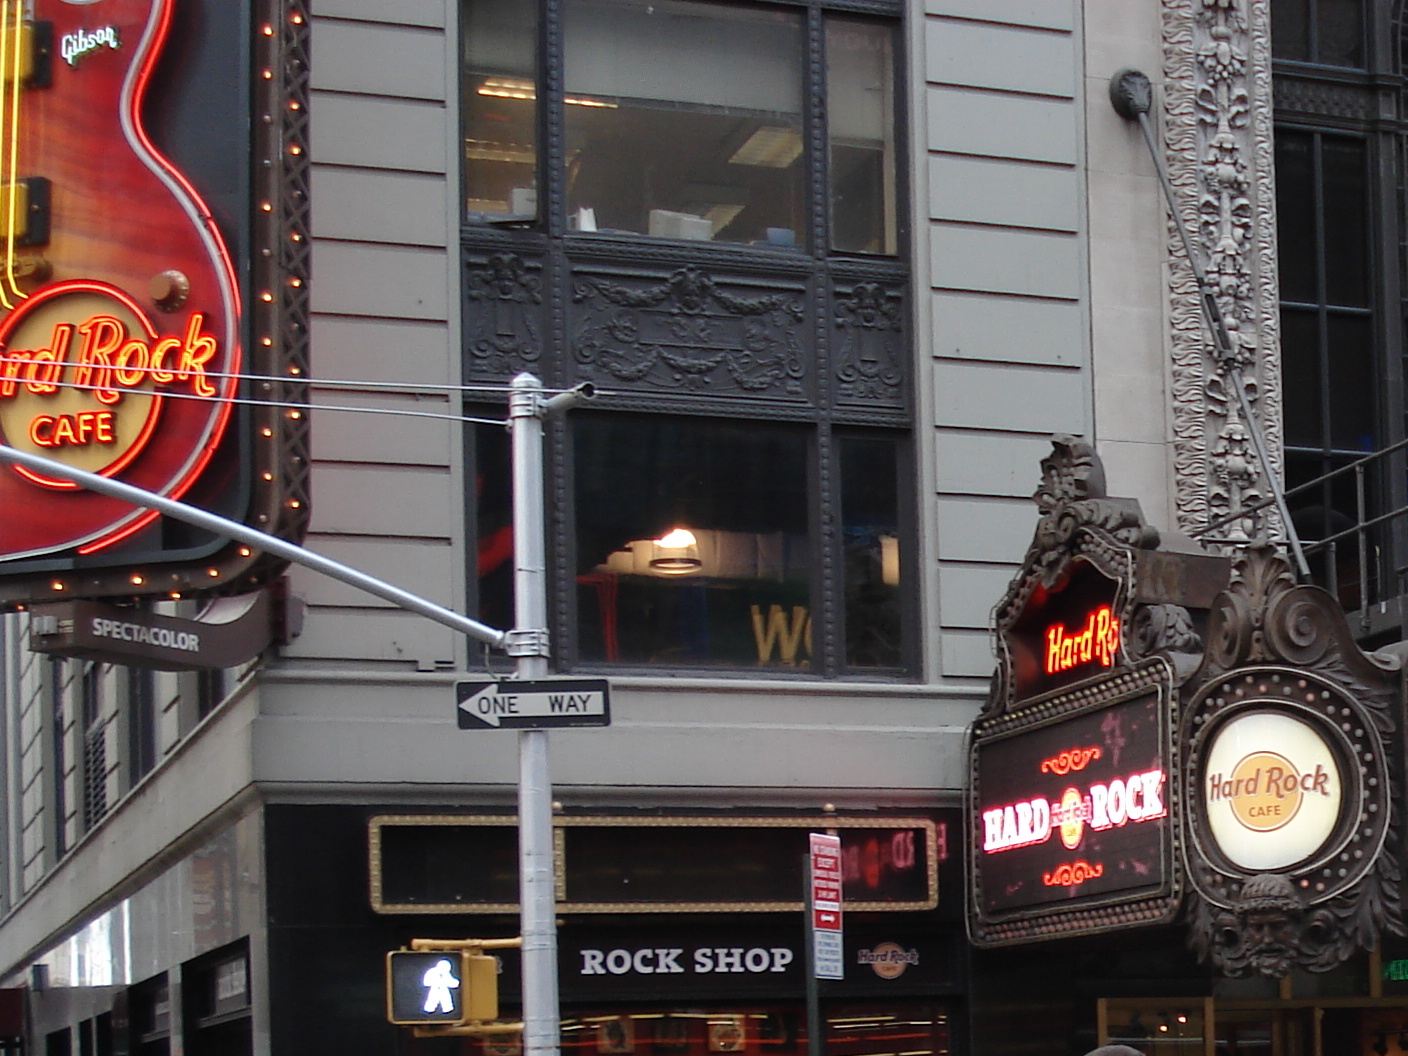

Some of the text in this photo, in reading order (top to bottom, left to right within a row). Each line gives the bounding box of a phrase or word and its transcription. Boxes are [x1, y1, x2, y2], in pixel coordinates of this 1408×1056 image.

[62, 26, 117, 65] Gibson
[0, 313, 217, 404] rd Rock
[29, 411, 113, 447] CAFE
[92, 618, 199, 651] SPECTACOLOR
[1046, 612, 1096, 674] Hard
[478, 694, 592, 714] ONE WAY
[1209, 764, 1330, 801] Hard Rock
[983, 798, 1052, 854] HARD
[1089, 770, 1167, 832] ROCK
[1248, 805, 1281, 818] CAFE
[580, 949, 684, 974] ROCK
[694, 948, 793, 973] SHOP
[858, 949, 889, 964] Hard
